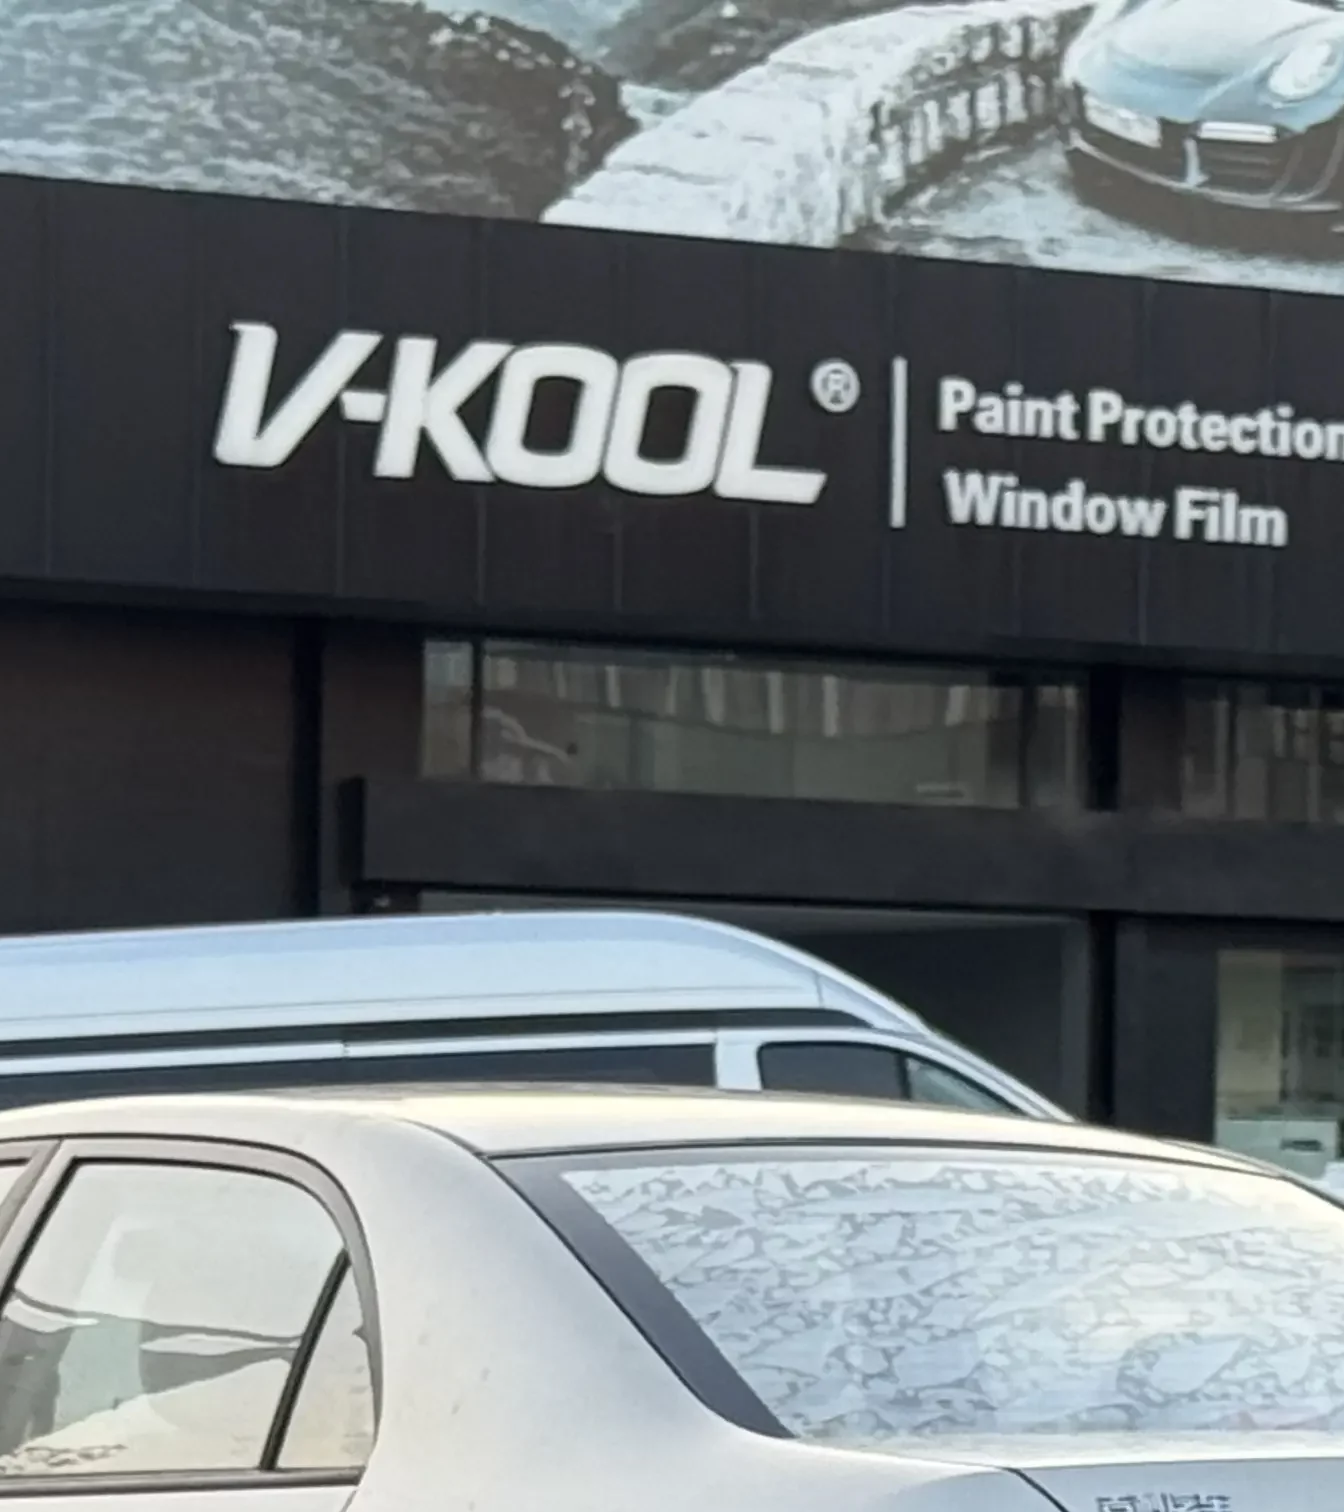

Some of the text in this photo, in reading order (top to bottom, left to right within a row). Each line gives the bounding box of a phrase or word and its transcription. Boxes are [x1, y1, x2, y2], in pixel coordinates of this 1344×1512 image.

[214, 322, 826, 505] V-KOOL
[940, 377, 1080, 441] Paint
[942, 468, 1289, 548] Window Film
